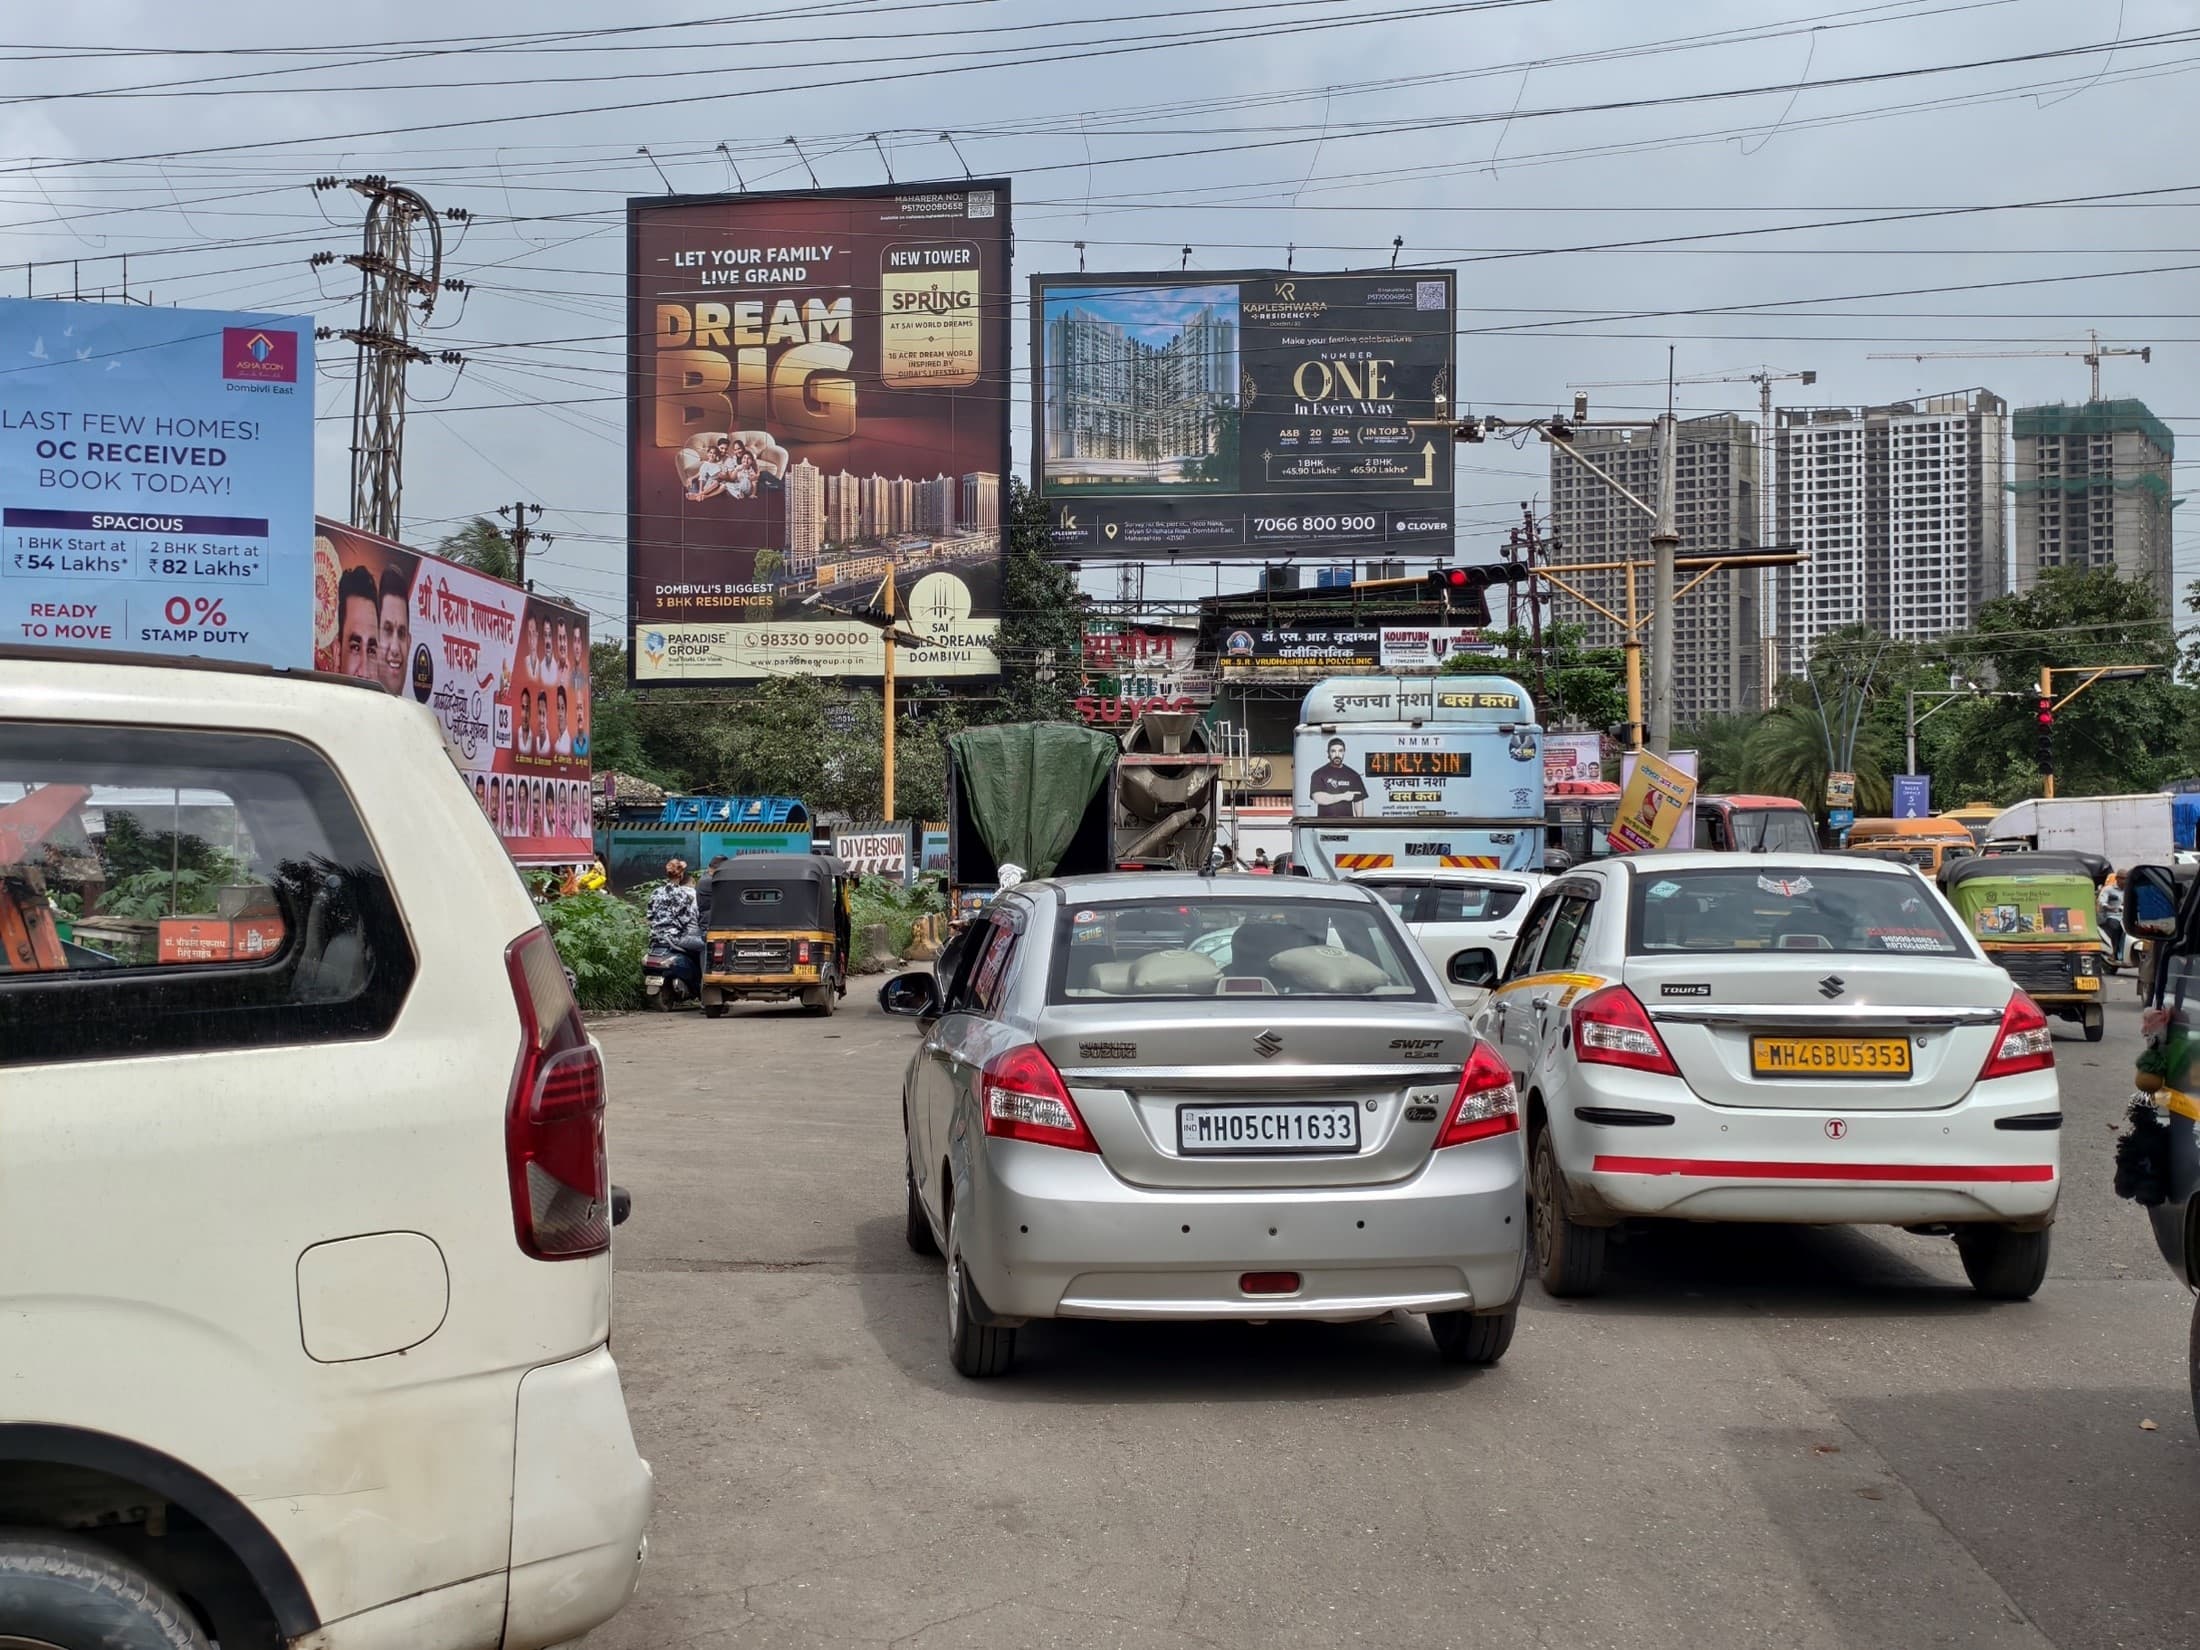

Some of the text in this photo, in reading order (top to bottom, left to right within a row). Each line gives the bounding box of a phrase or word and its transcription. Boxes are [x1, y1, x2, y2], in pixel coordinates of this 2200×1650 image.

[675, 245, 834, 267] LET YOUR FAMILY
[891, 249, 970, 266] NEW TOWER
[701, 267, 807, 285] LIVE GRAND
[891, 288, 971, 315] SPRING
[1242, 301, 1328, 313] KAPLESHWARA
[656, 297, 853, 348] DREAM
[1259, 312, 1311, 320] RESIDENCY
[890, 322, 900, 330] AT
[915, 321, 942, 329] WORLD
[943, 320, 974, 328] DREAMS
[1281, 337, 1306, 345] Make
[1306, 337, 1327, 346] your
[898, 349, 974, 359] ACRE DREAM WORLD
[1320, 351, 1374, 360] NUMBER
[908, 359, 954, 368] INSPIRED BY
[1293, 359, 1395, 402] ONE
[226, 383, 294, 395] Dombivli East
[655, 342, 858, 448] BIG
[1294, 402, 1395, 418] In Every Way
[2, 409, 261, 441] LAST FEW HOMES!
[1366, 427, 1408, 436] IN TOP 3
[1279, 429, 1300, 437] A&B
[1309, 428, 1322, 437] 20
[36, 440, 228, 467] OC RECEIVED
[1304, 459, 1324, 467] BHK
[1365, 458, 1393, 466] 2 BHK
[40, 468, 232, 496] BOOK TODAY!
[91, 514, 184, 532] SPACIOUS
[1254, 515, 1376, 532] 7066 800 900
[1407, 522, 1448, 531] CLOVER
[17, 537, 127, 553] 1 BHK Start at
[150, 542, 260, 558] 2 BHK Start at
[655, 583, 775, 595] DOMBIVLI'S BIGGEST
[656, 596, 774, 608] 3 BHK RESIDENCES
[30, 603, 98, 619] READY
[164, 595, 228, 627] 0%
[21, 623, 113, 640] TO MOVE
[932, 623, 949, 633] SAI
[141, 628, 250, 645] STAMP DUTY
[667, 633, 727, 645] PARADISE
[760, 632, 869, 647] 98330 90000
[1383, 631, 1430, 642] KOUSTUBH
[668, 644, 710, 656] GROUP
[909, 650, 972, 663] DOMBIVLI
[1318, 658, 1325, 666] &
[1325, 657, 1373, 665] POLYCLINIC
[1396, 693, 1433, 707] नशा
[498, 708, 509, 729] 03
[840, 836, 905, 858] DIVERSION
[1388, 1039, 1445, 1049] SWIFT
[1079, 1049, 1137, 1059] SUZUKI
[1769, 1043, 1906, 1067] MH46BU5353
[1183, 1124, 1198, 1132] IND
[1198, 1114, 1352, 1142] MH05CH1633
[1830, 1122, 1843, 1137] T
